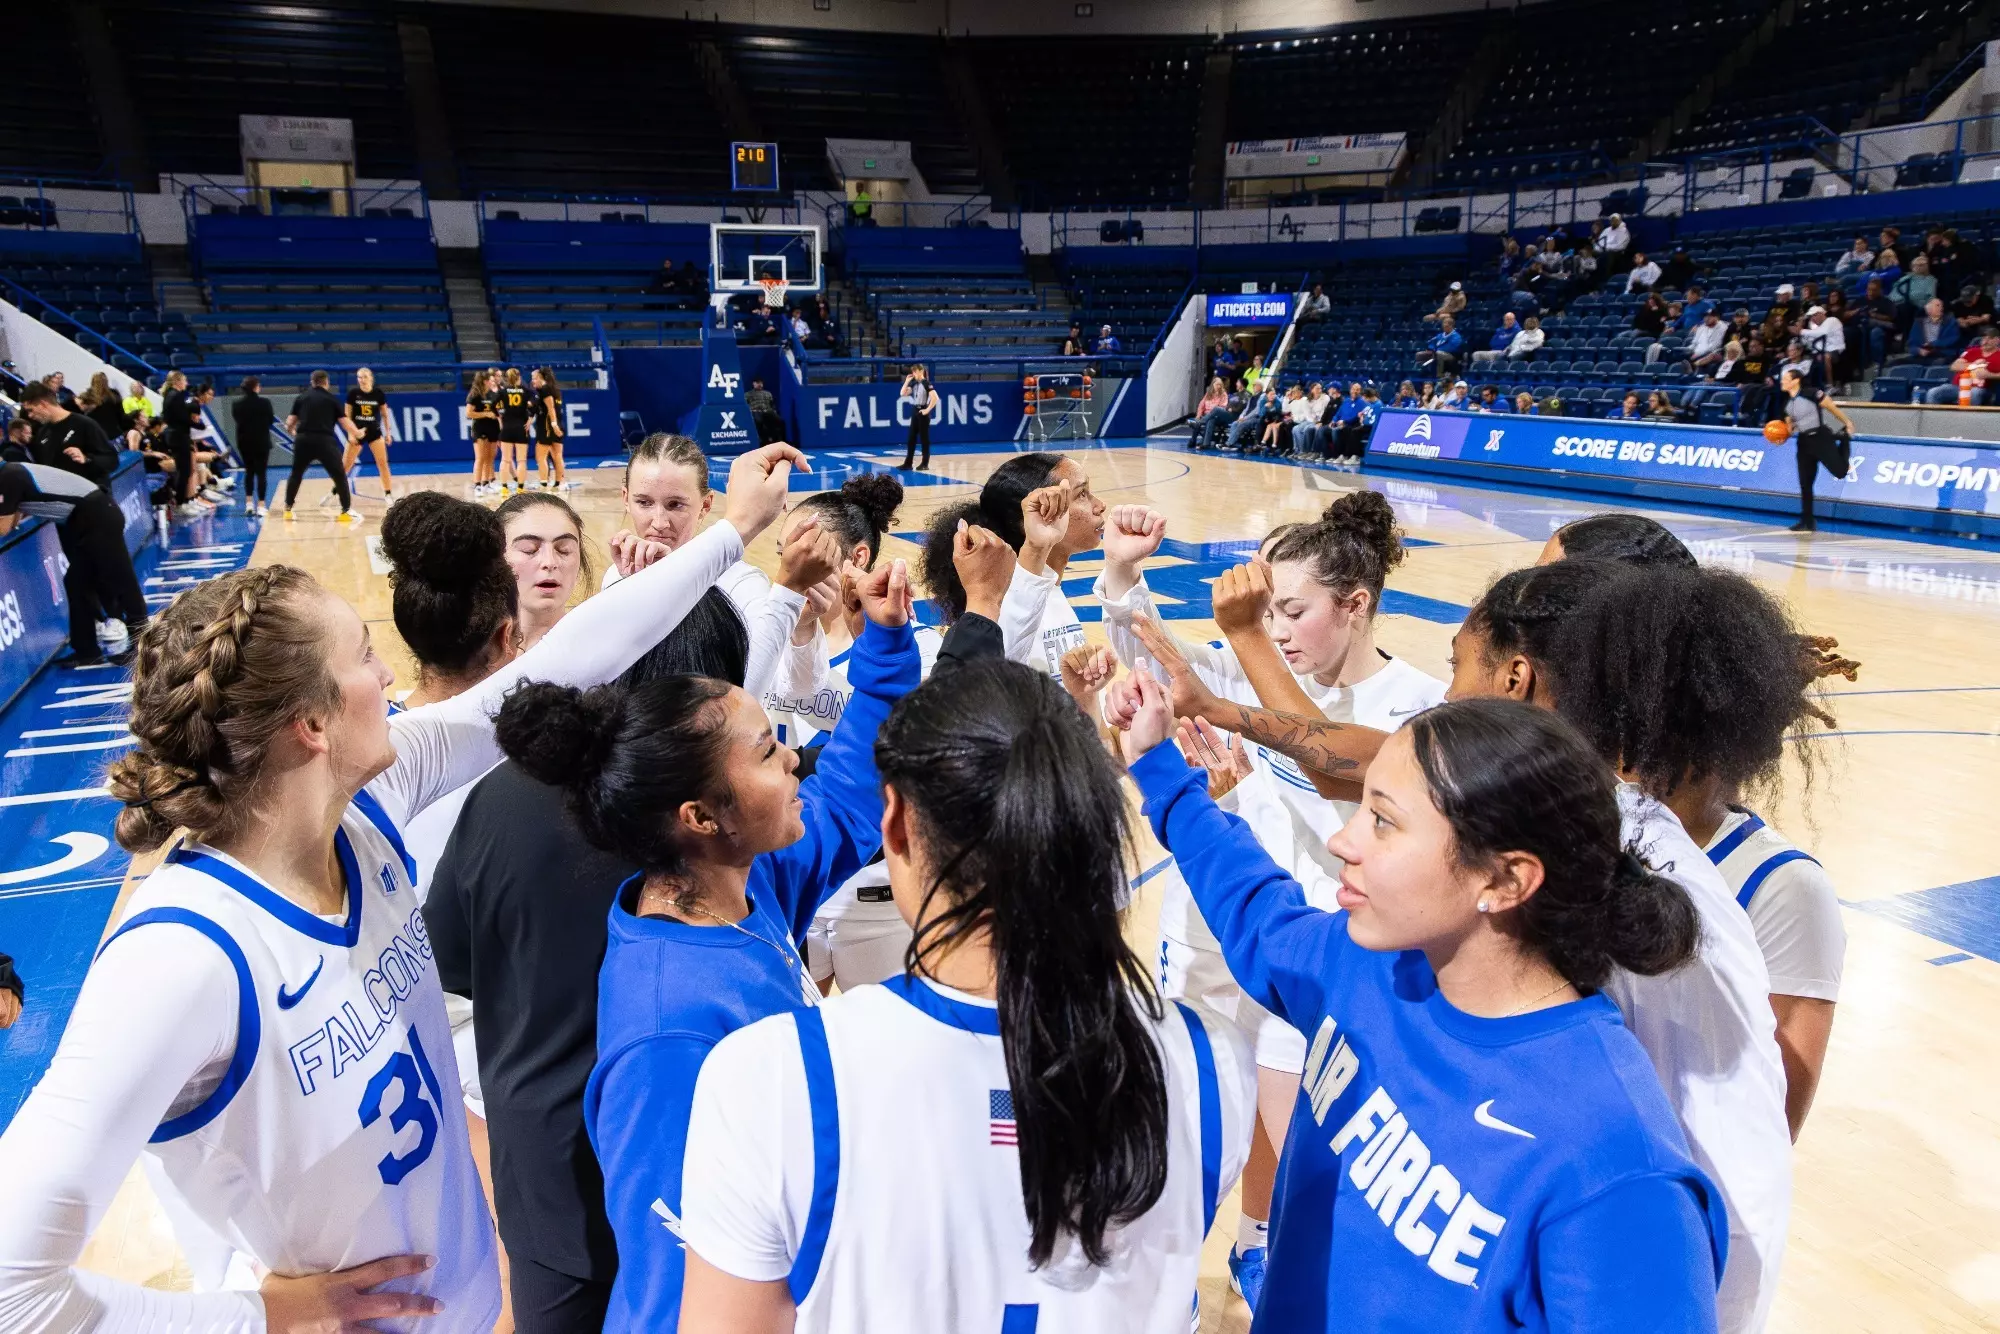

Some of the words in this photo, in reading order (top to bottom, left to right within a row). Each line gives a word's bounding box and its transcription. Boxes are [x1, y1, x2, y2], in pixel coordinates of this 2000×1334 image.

[1213, 302, 1286, 317] AFTICKETS.COM
[707, 363, 740, 398] AF
[361, 405, 373, 416] 15
[381, 406, 441, 442] AIR
[818, 393, 992, 429] FALCONS
[711, 430, 748, 439] EXCHANGE
[1387, 441, 1441, 458] amentum
[1552, 436, 1618, 459] SCORE
[1617, 441, 1656, 462] BIG
[1657, 443, 1764, 472] SAVINGS!
[763, 689, 852, 720] ALCON
[288, 907, 433, 1096] FALCONS
[1302, 1014, 1360, 1128] AIR
[1329, 1085, 1507, 1286] FORCE
